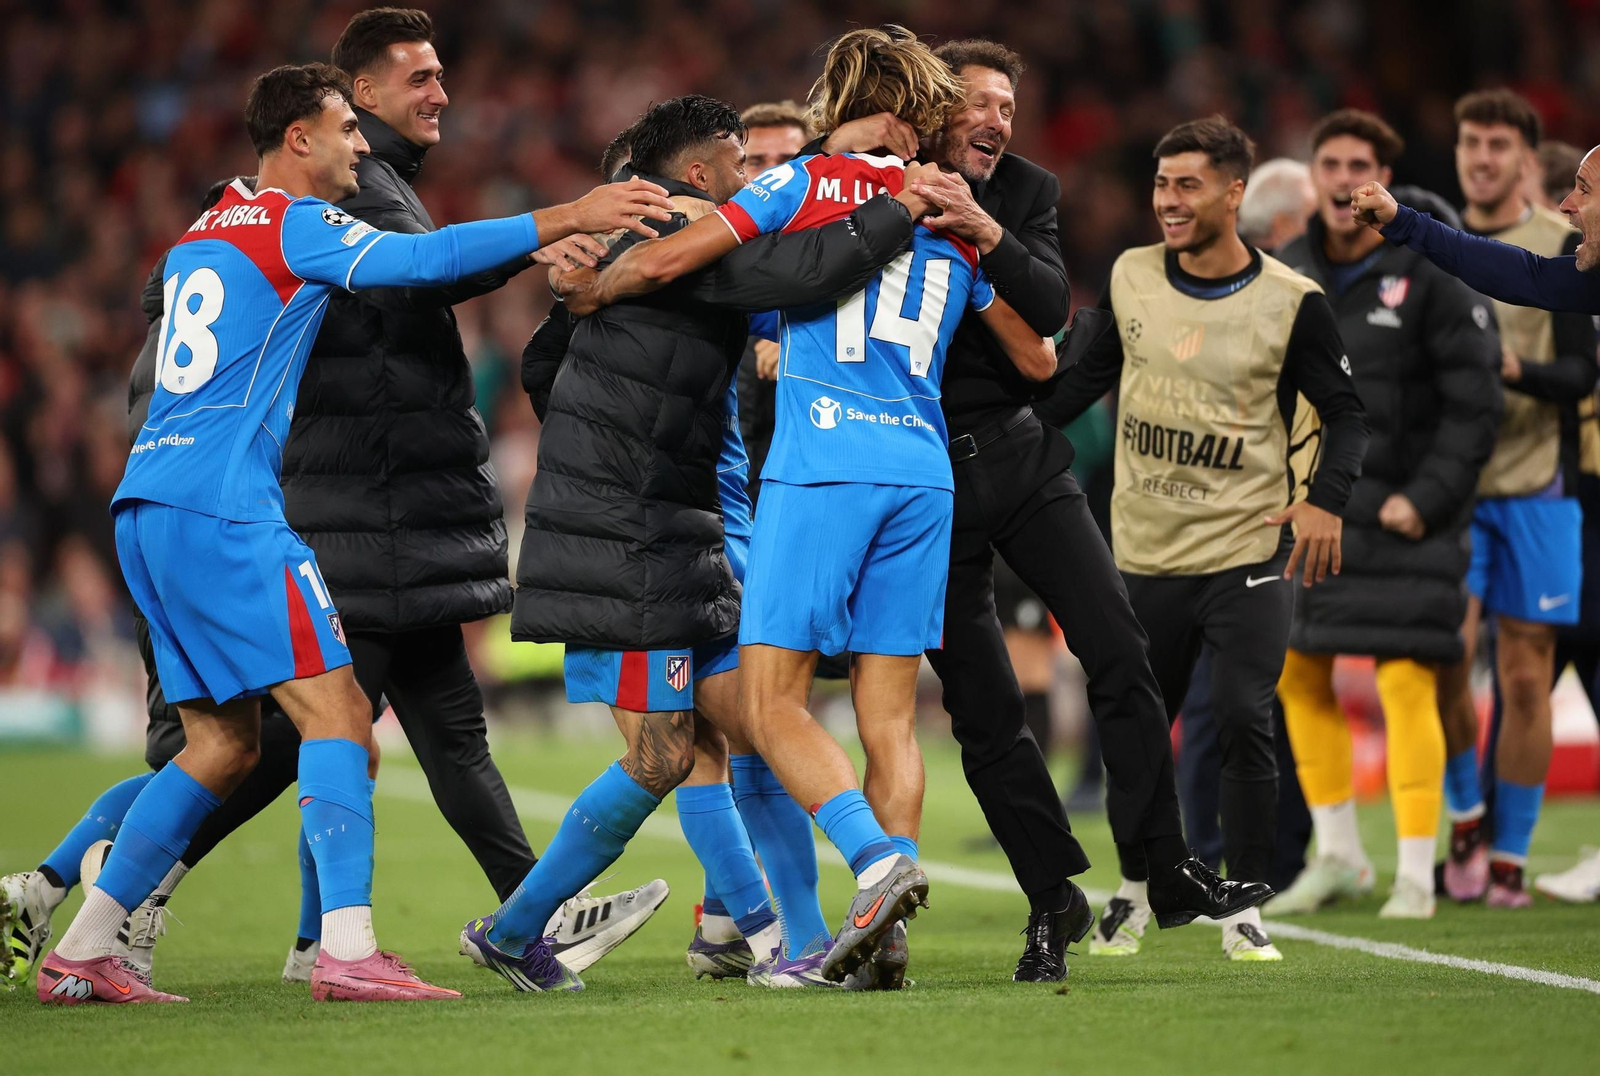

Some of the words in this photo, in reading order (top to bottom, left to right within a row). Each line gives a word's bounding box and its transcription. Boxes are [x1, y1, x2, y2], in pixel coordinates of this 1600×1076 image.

[816, 176, 848, 204] M.
[210, 204, 272, 230] PUBILL
[836, 250, 952, 380] 14
[154, 266, 225, 395] 18
[846, 407, 877, 423] Save
[879, 412, 900, 426] the
[1142, 477, 1211, 501] RESPECT
